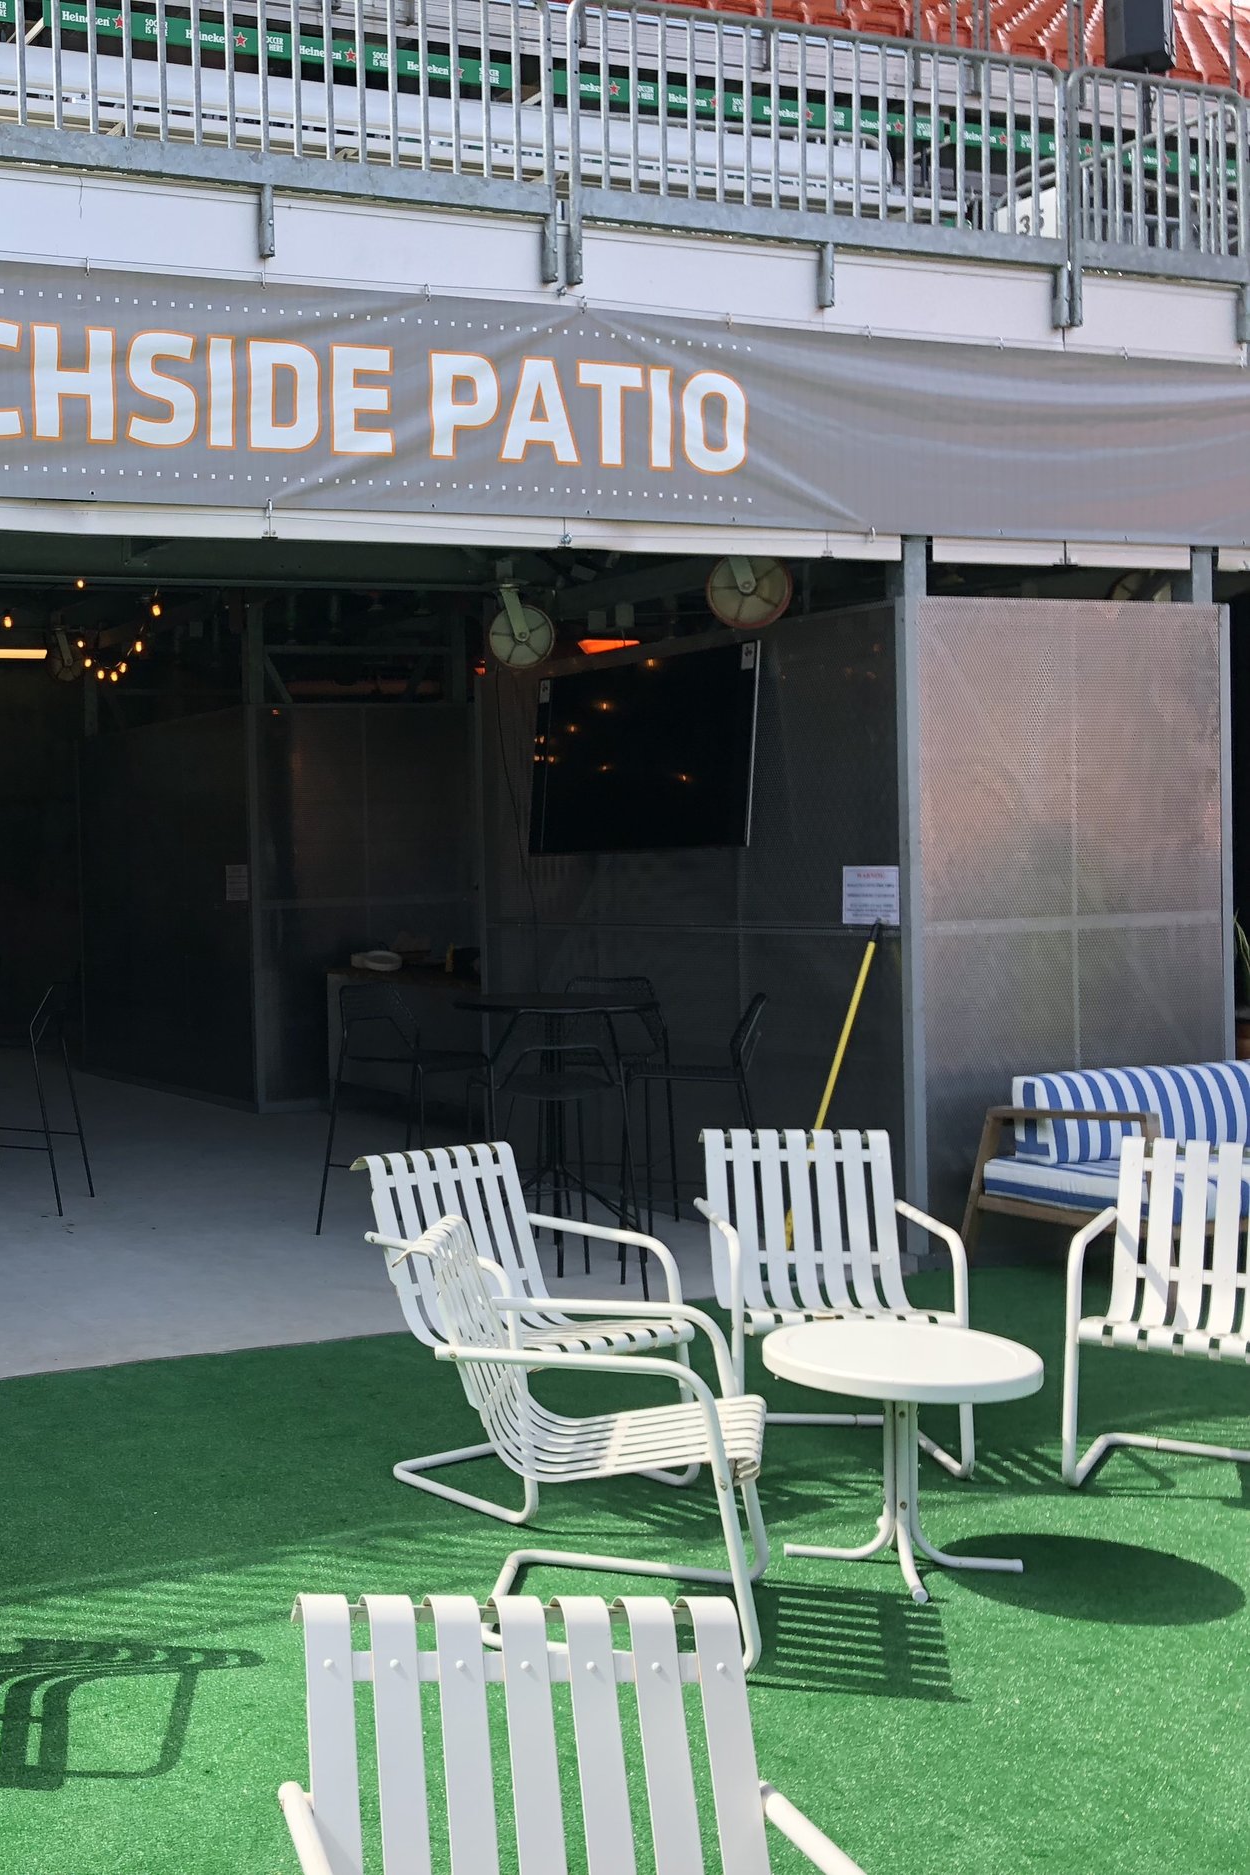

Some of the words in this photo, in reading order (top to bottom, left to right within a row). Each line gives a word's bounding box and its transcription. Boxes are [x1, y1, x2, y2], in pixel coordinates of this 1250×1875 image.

[62, 10, 110, 26] Heinen
[299, 45, 342, 60] Heineen
[406, 60, 449, 75] Heeken
[429, 349, 747, 476] PATIO
